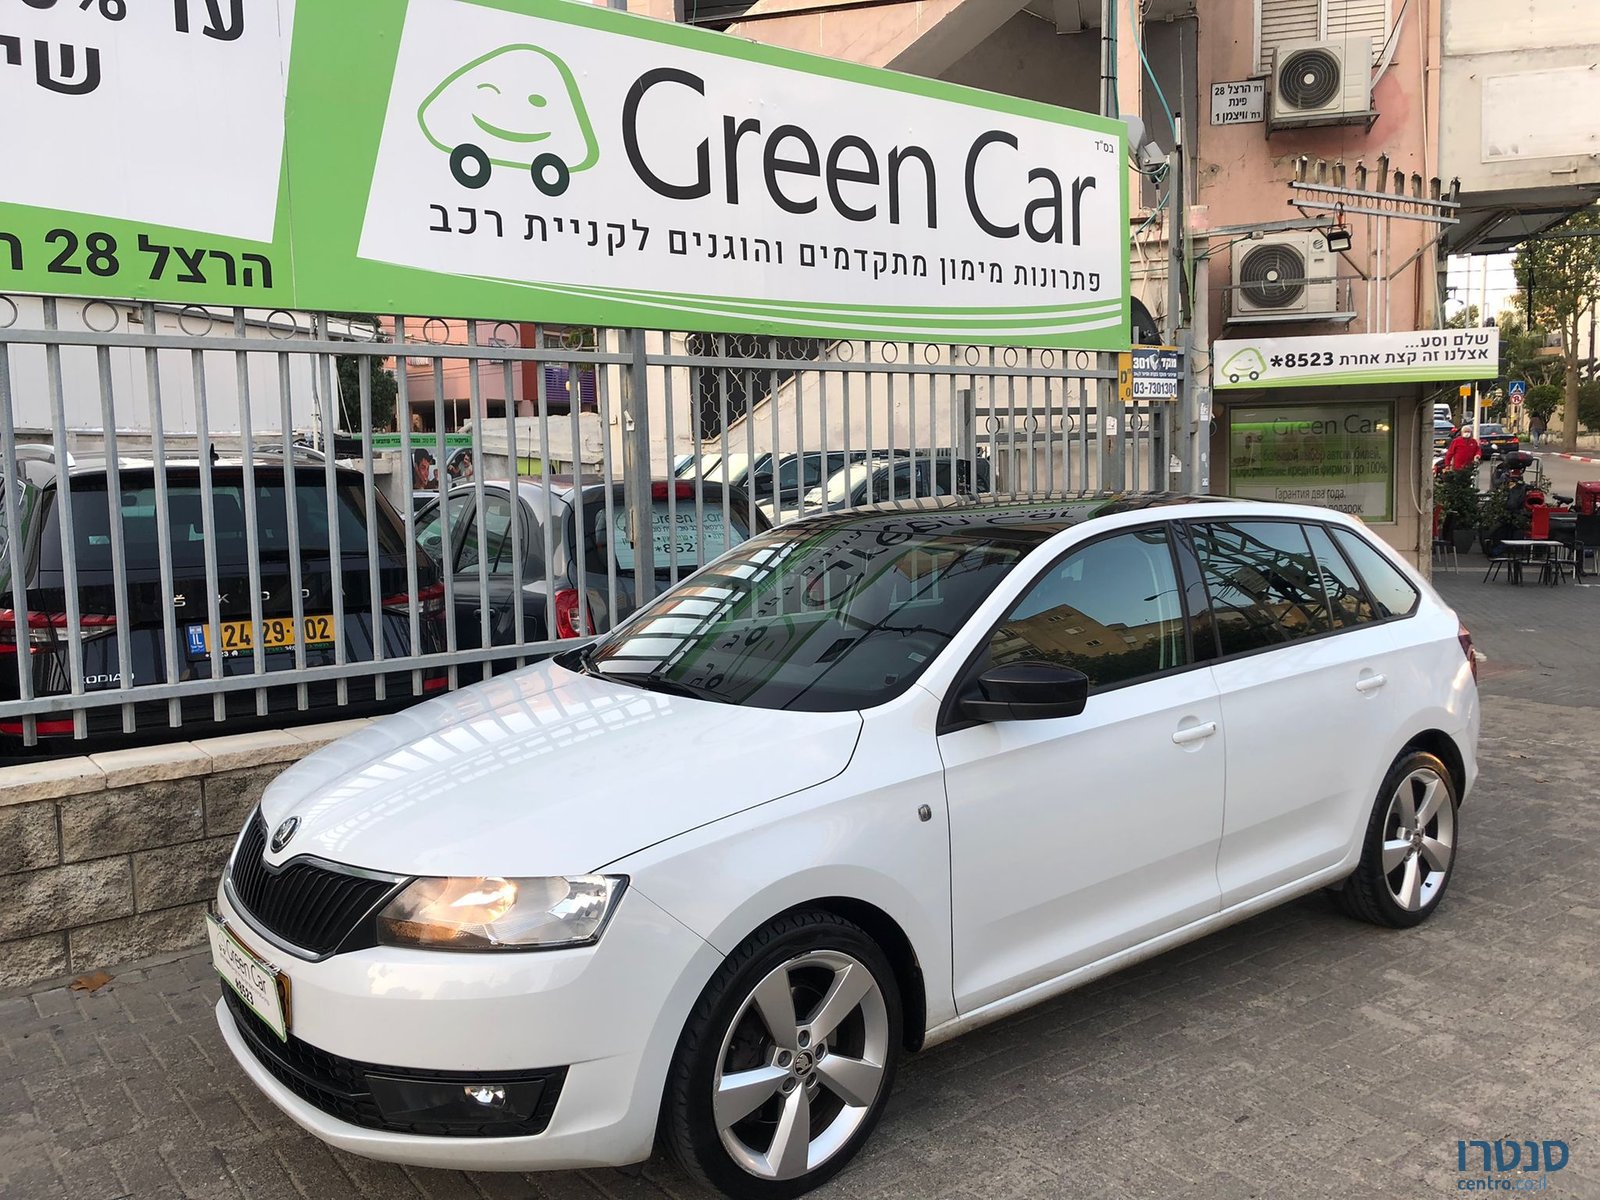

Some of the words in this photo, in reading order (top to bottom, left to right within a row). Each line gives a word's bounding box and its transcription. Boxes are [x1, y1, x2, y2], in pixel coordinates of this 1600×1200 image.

[1214, 86, 1226, 96] 28
[1227, 84, 1251, 95] הרצל
[1228, 97, 1248, 107] פינת
[1215, 113, 1220, 121] 1
[621, 67, 937, 229] Green
[964, 129, 1096, 246] Car
[429, 203, 504, 238] רכב
[523, 212, 650, 257] לקניית
[44, 228, 120, 277] 28
[667, 228, 783, 264] והוגנים
[137, 233, 273, 289] הרצל
[799, 243, 928, 280] מתקדמים
[939, 256, 1003, 285] מימון
[1013, 264, 1101, 292] פתרונות
[1453, 332, 1490, 346] שלם
[1338, 353, 1380, 366] אחרת
[1384, 351, 1418, 366] קצת
[1422, 349, 1440, 362] זה
[1444, 347, 1489, 362] אצלנו
[1133, 357, 1150, 369] 301
[1134, 382, 1177, 395] 03-7301301
[1272, 416, 1338, 436] Green
